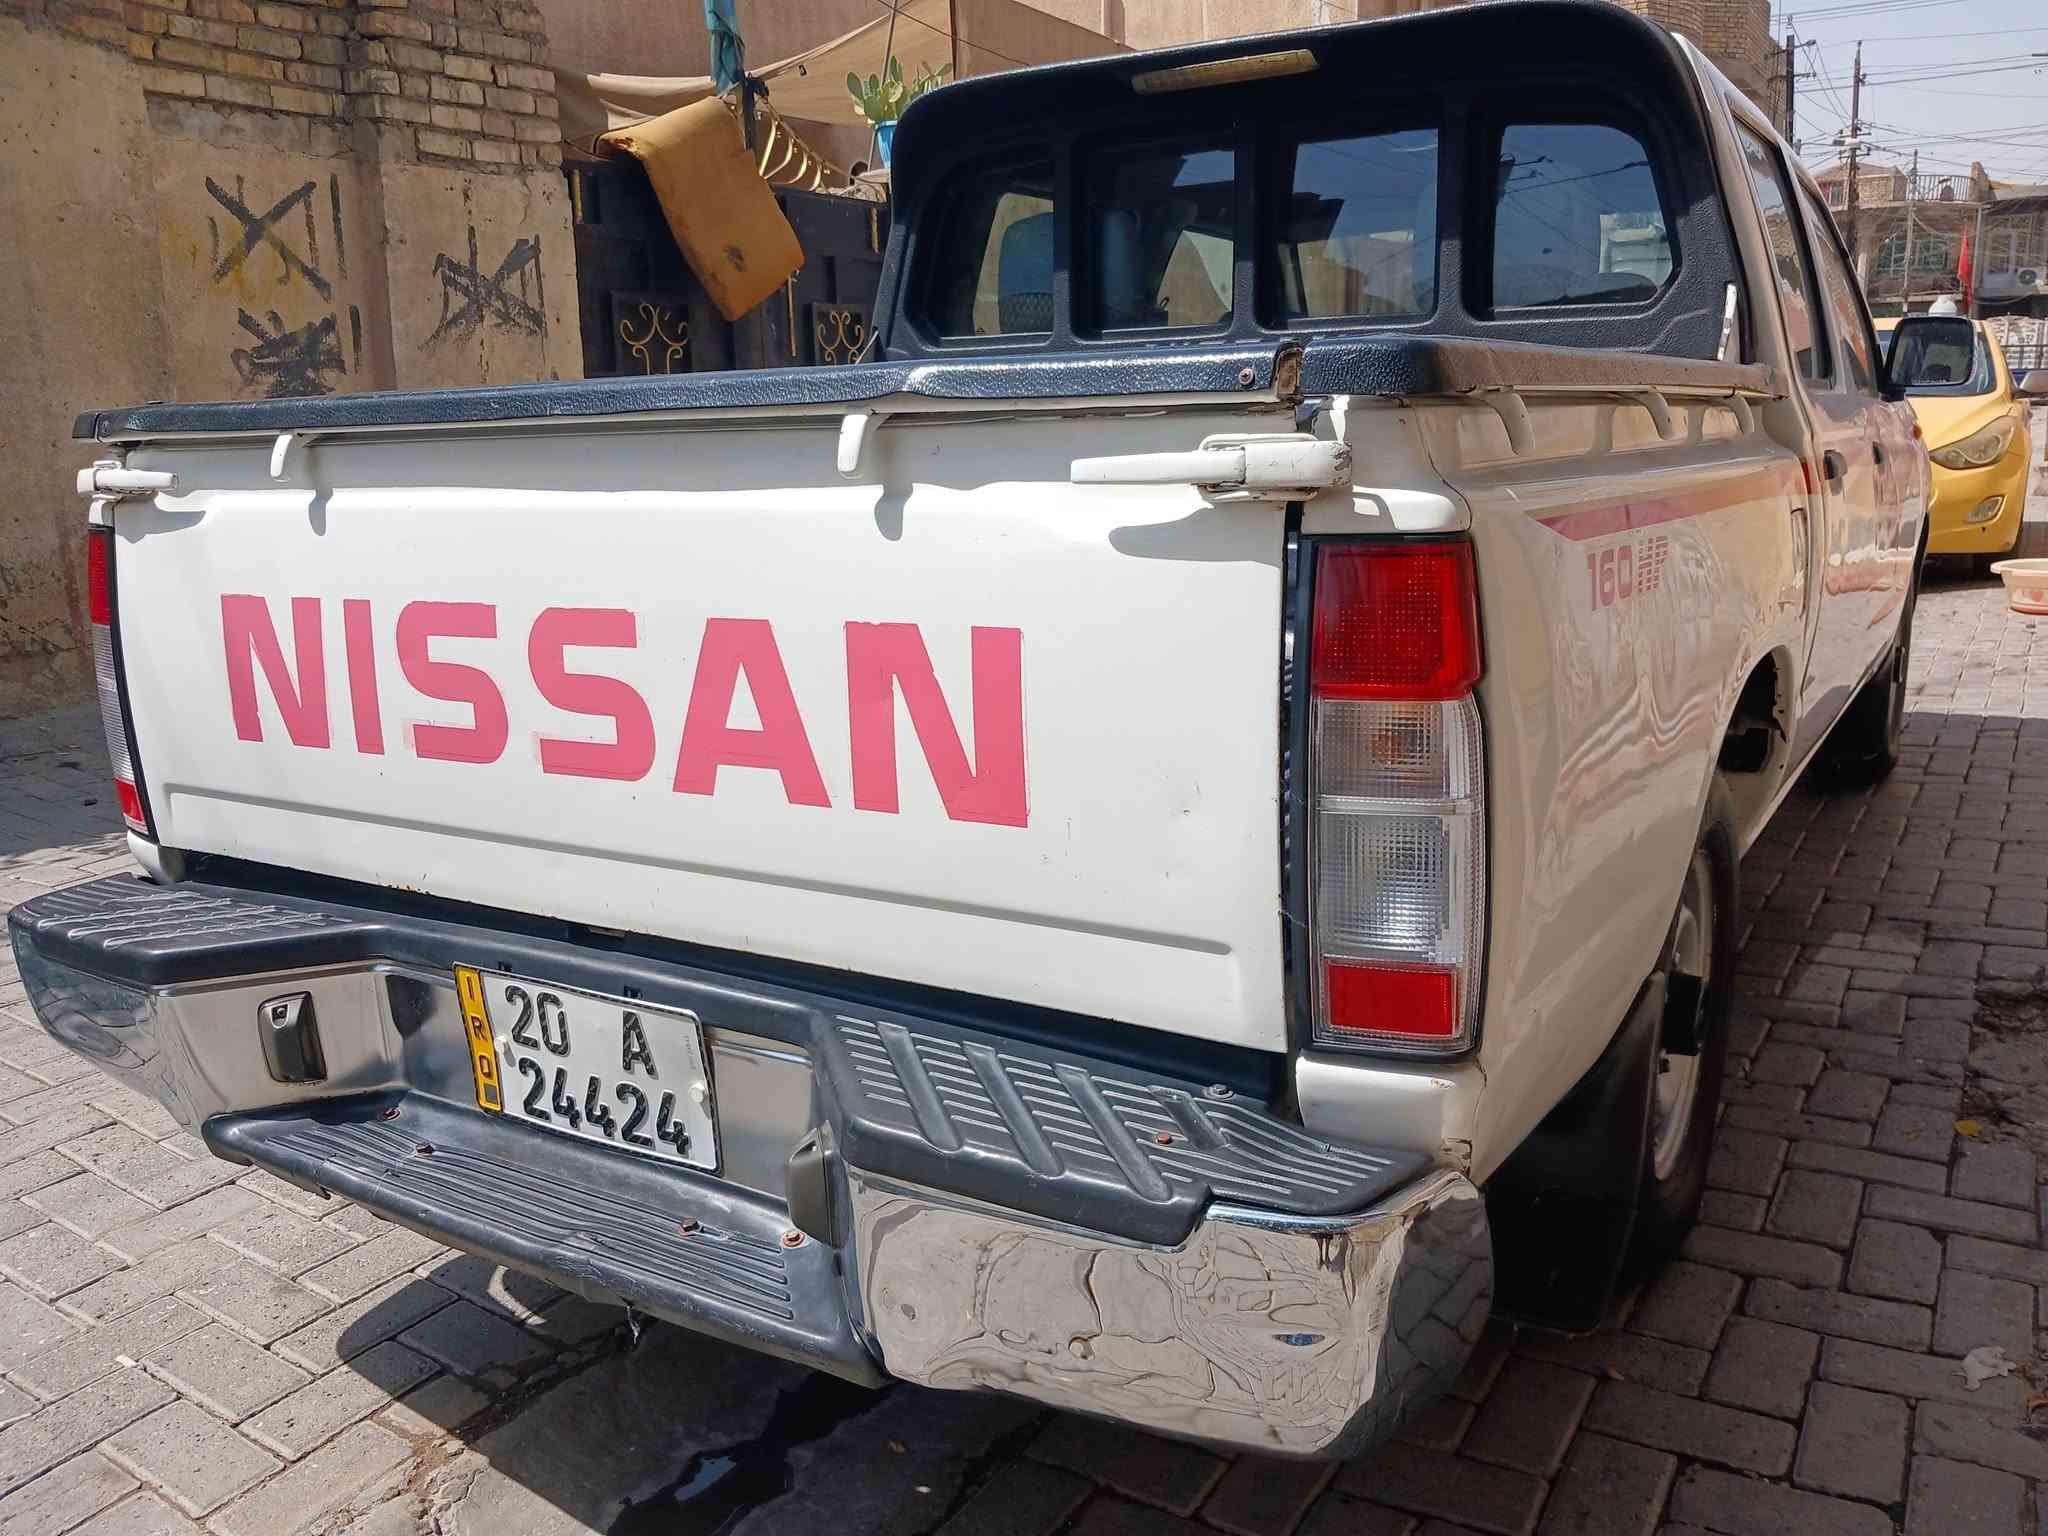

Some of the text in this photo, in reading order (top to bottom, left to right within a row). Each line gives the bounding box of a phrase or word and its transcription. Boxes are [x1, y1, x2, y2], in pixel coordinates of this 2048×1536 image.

[220, 593, 1029, 829] NISSAN
[504, 984, 570, 1056] 20
[622, 1008, 658, 1080] A
[517, 1056, 691, 1156] 24424
